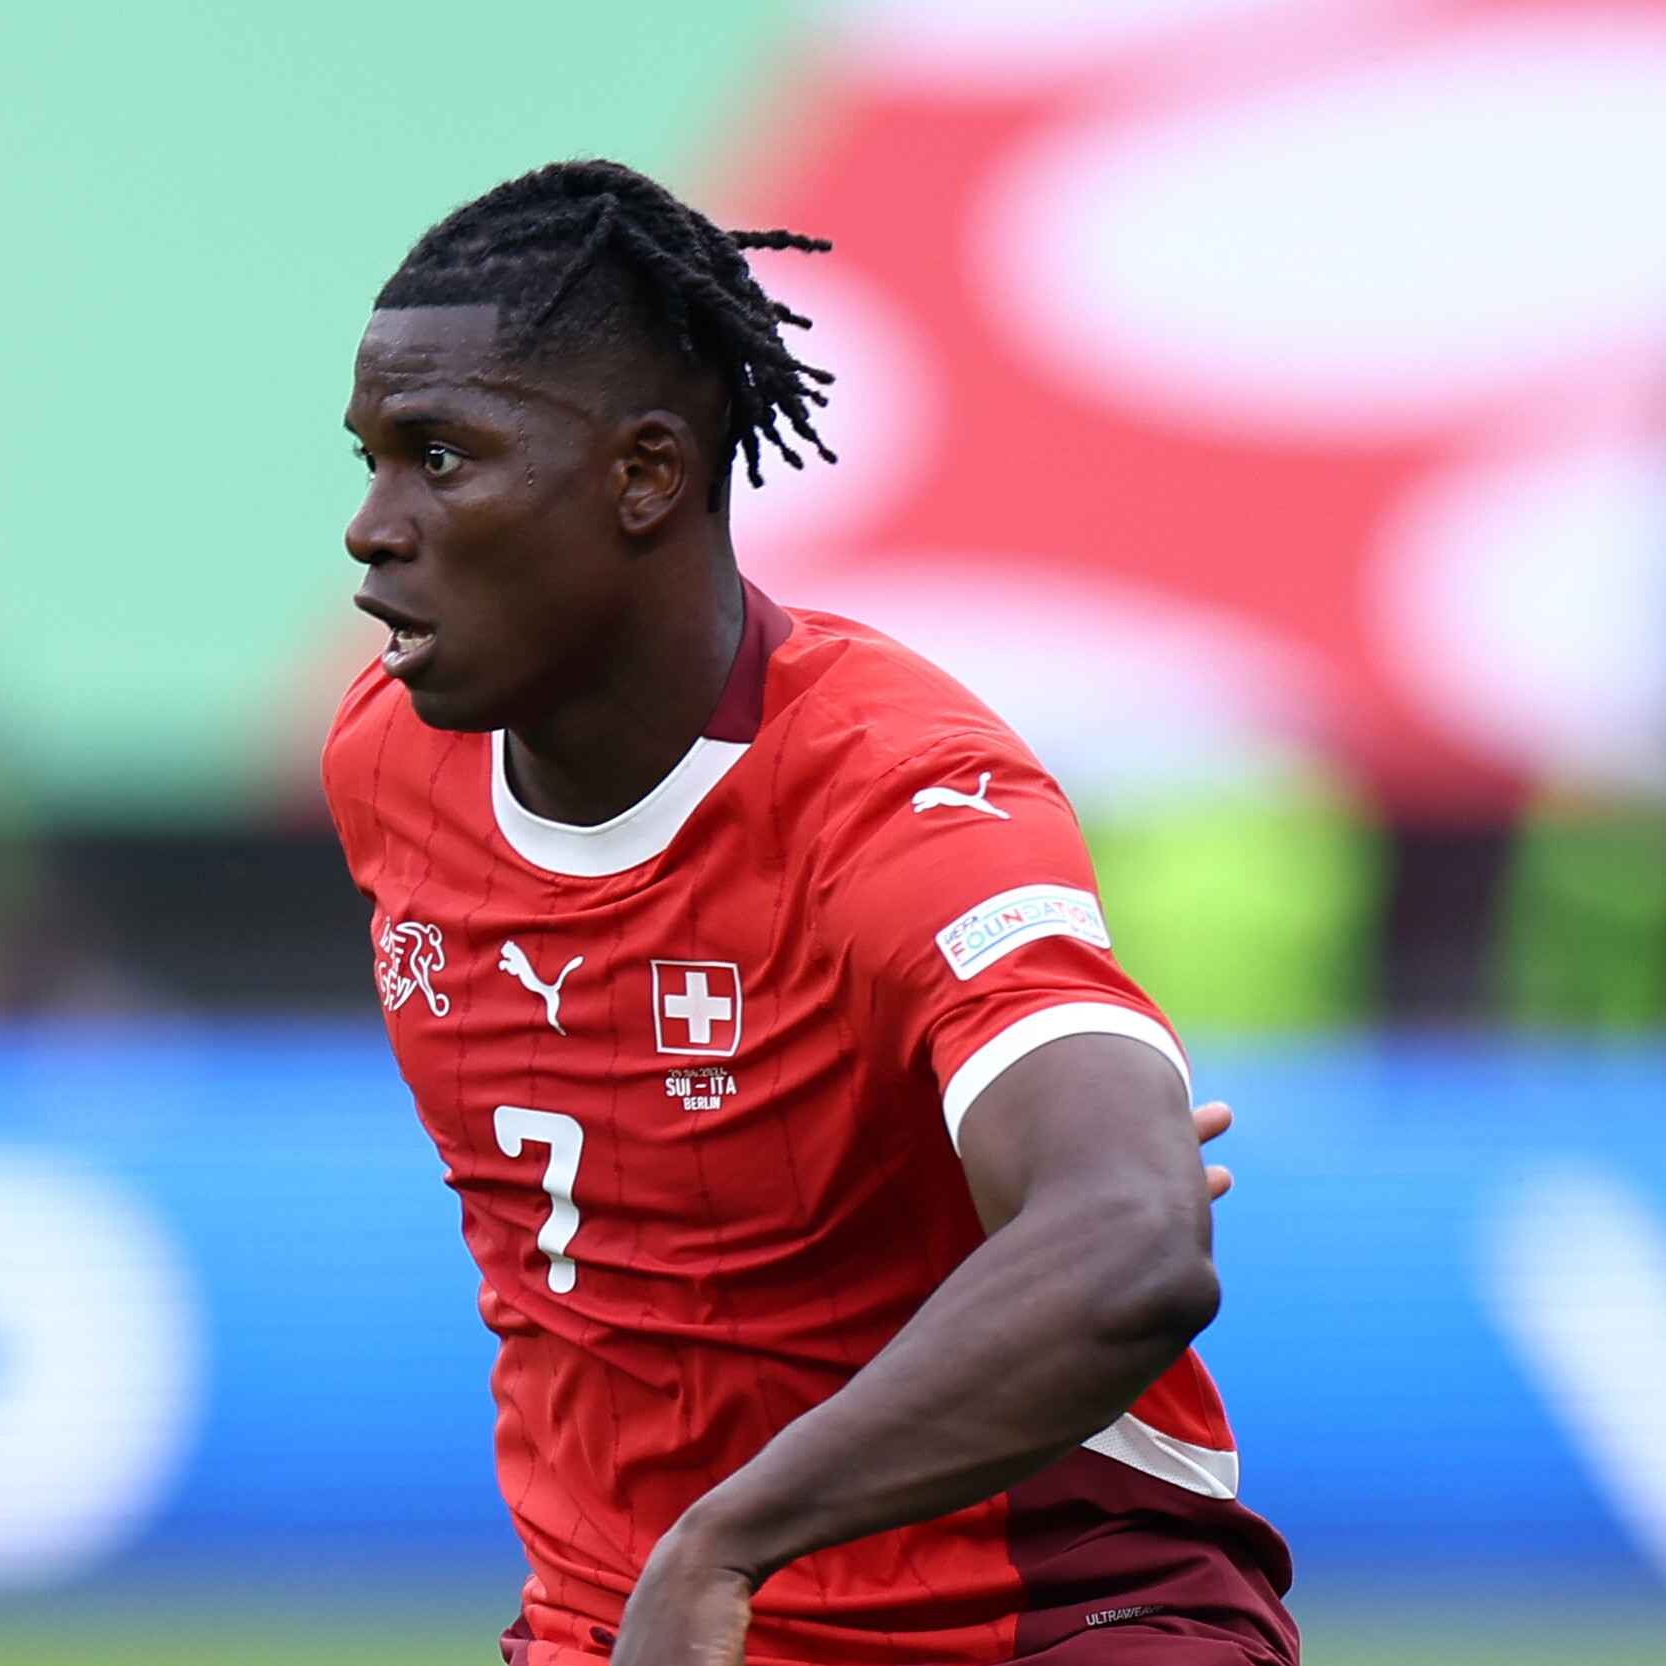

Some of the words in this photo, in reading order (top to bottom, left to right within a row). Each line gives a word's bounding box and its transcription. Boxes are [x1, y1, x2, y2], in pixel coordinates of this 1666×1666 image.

[950, 901, 1101, 962] FOUNDATION
[665, 1077, 691, 1097] SUI
[710, 1075, 738, 1095] ITA
[683, 1096, 721, 1111] BERLIN
[494, 1105, 584, 1292] 7
